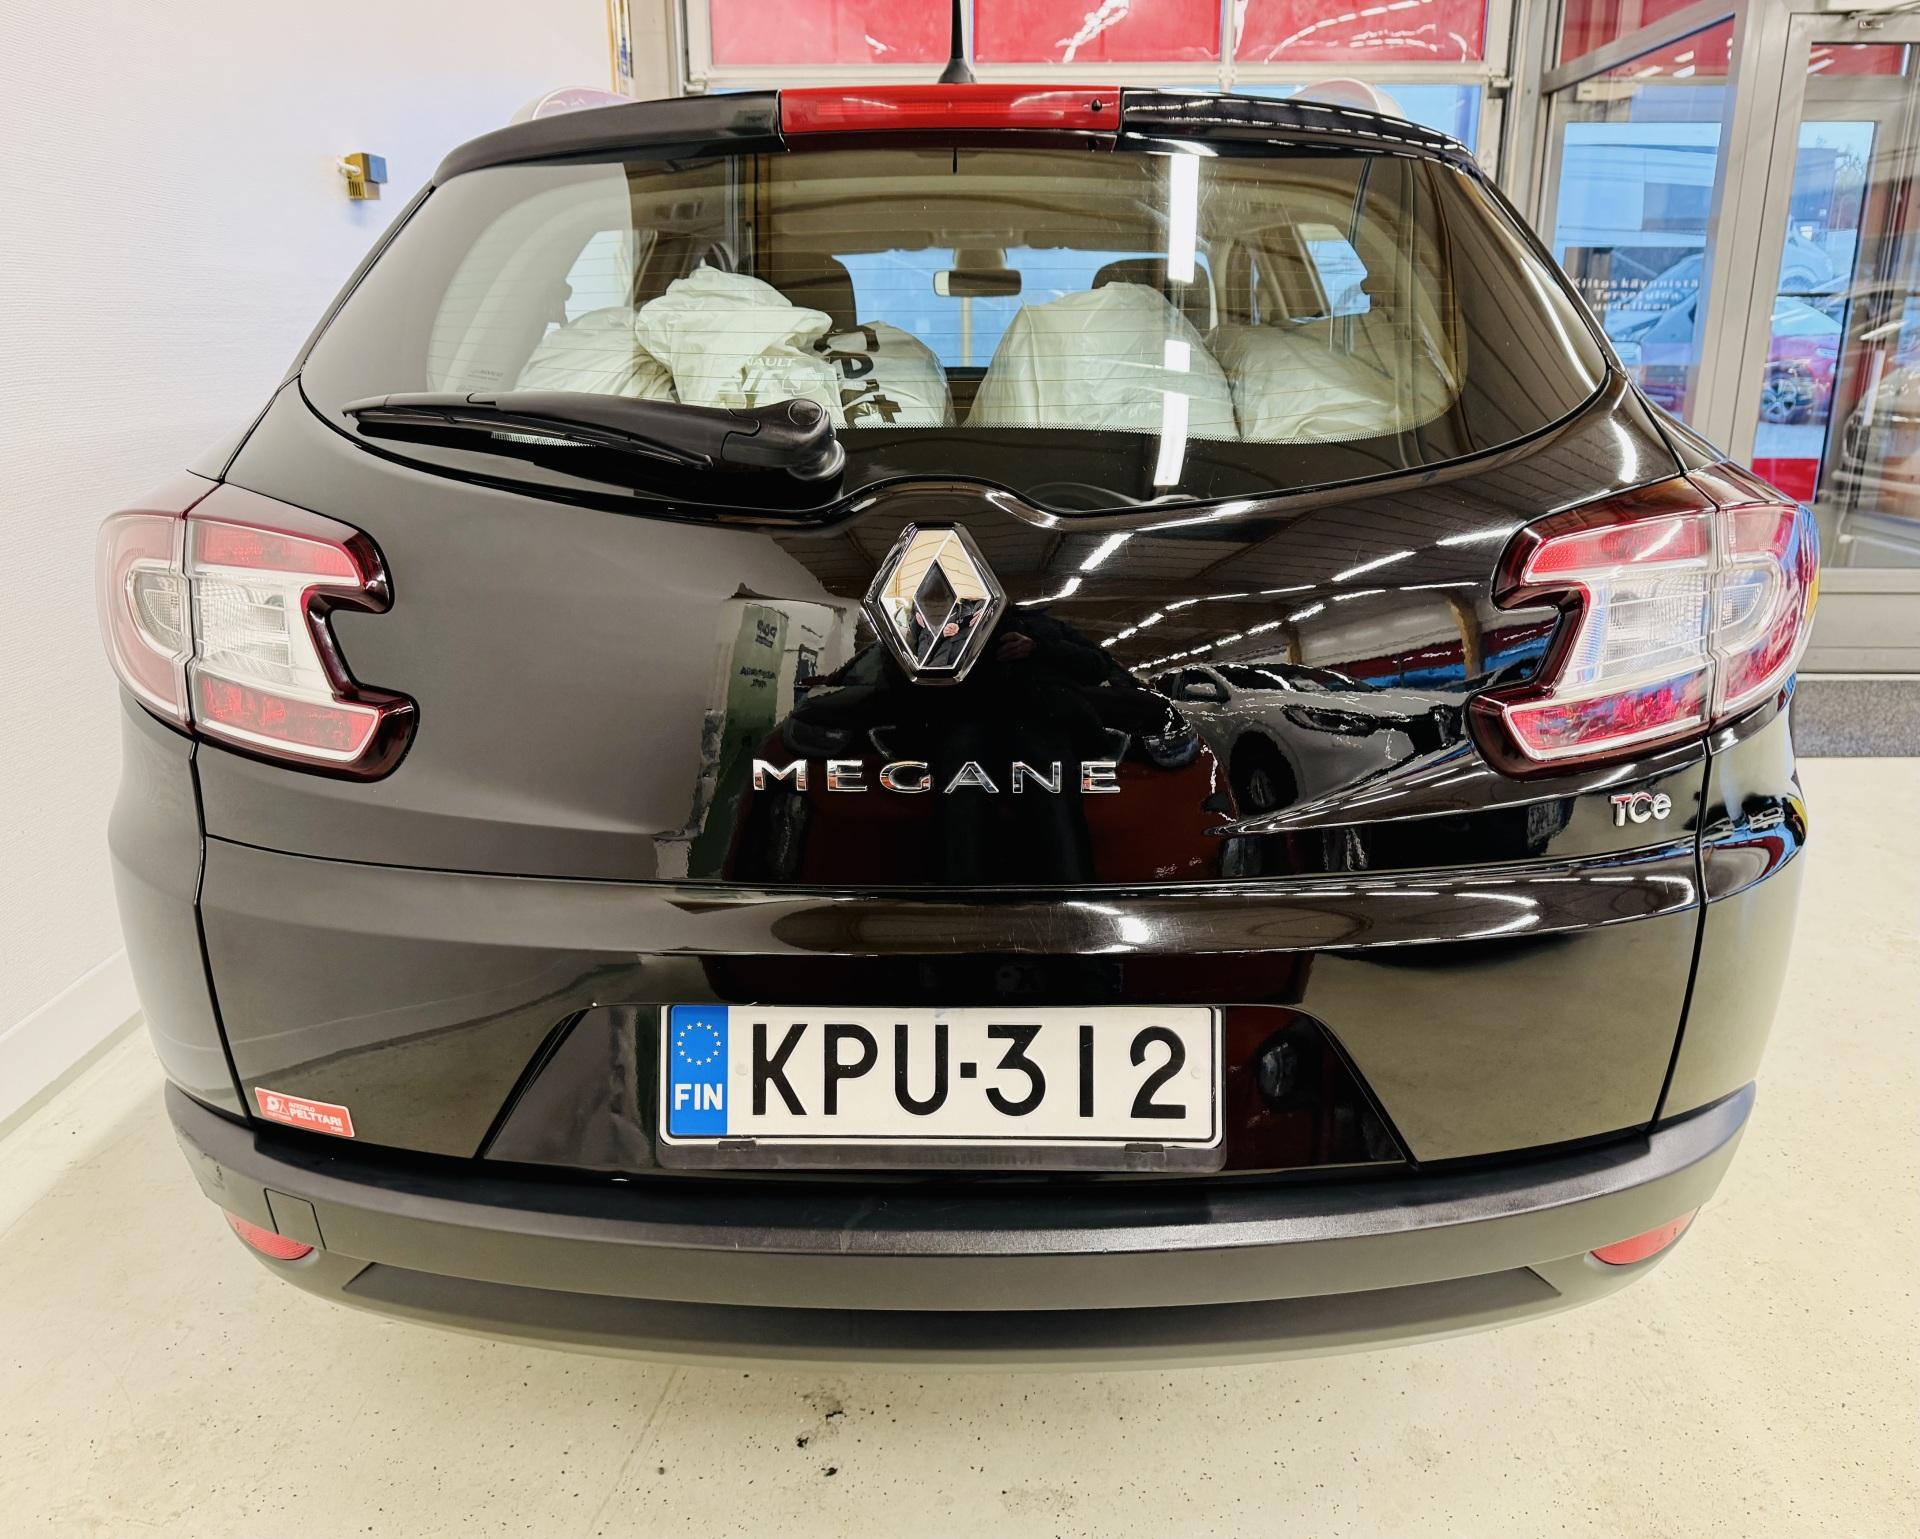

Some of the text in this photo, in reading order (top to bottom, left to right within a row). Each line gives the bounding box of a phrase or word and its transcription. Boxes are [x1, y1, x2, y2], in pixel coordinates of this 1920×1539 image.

[752, 758, 1122, 794] MEGANE
[1610, 791, 1672, 827] TCe
[751, 1023, 1187, 1120] KPU-312
[674, 1083, 723, 1111] FIN
[288, 1107, 343, 1127] PELTTARI
